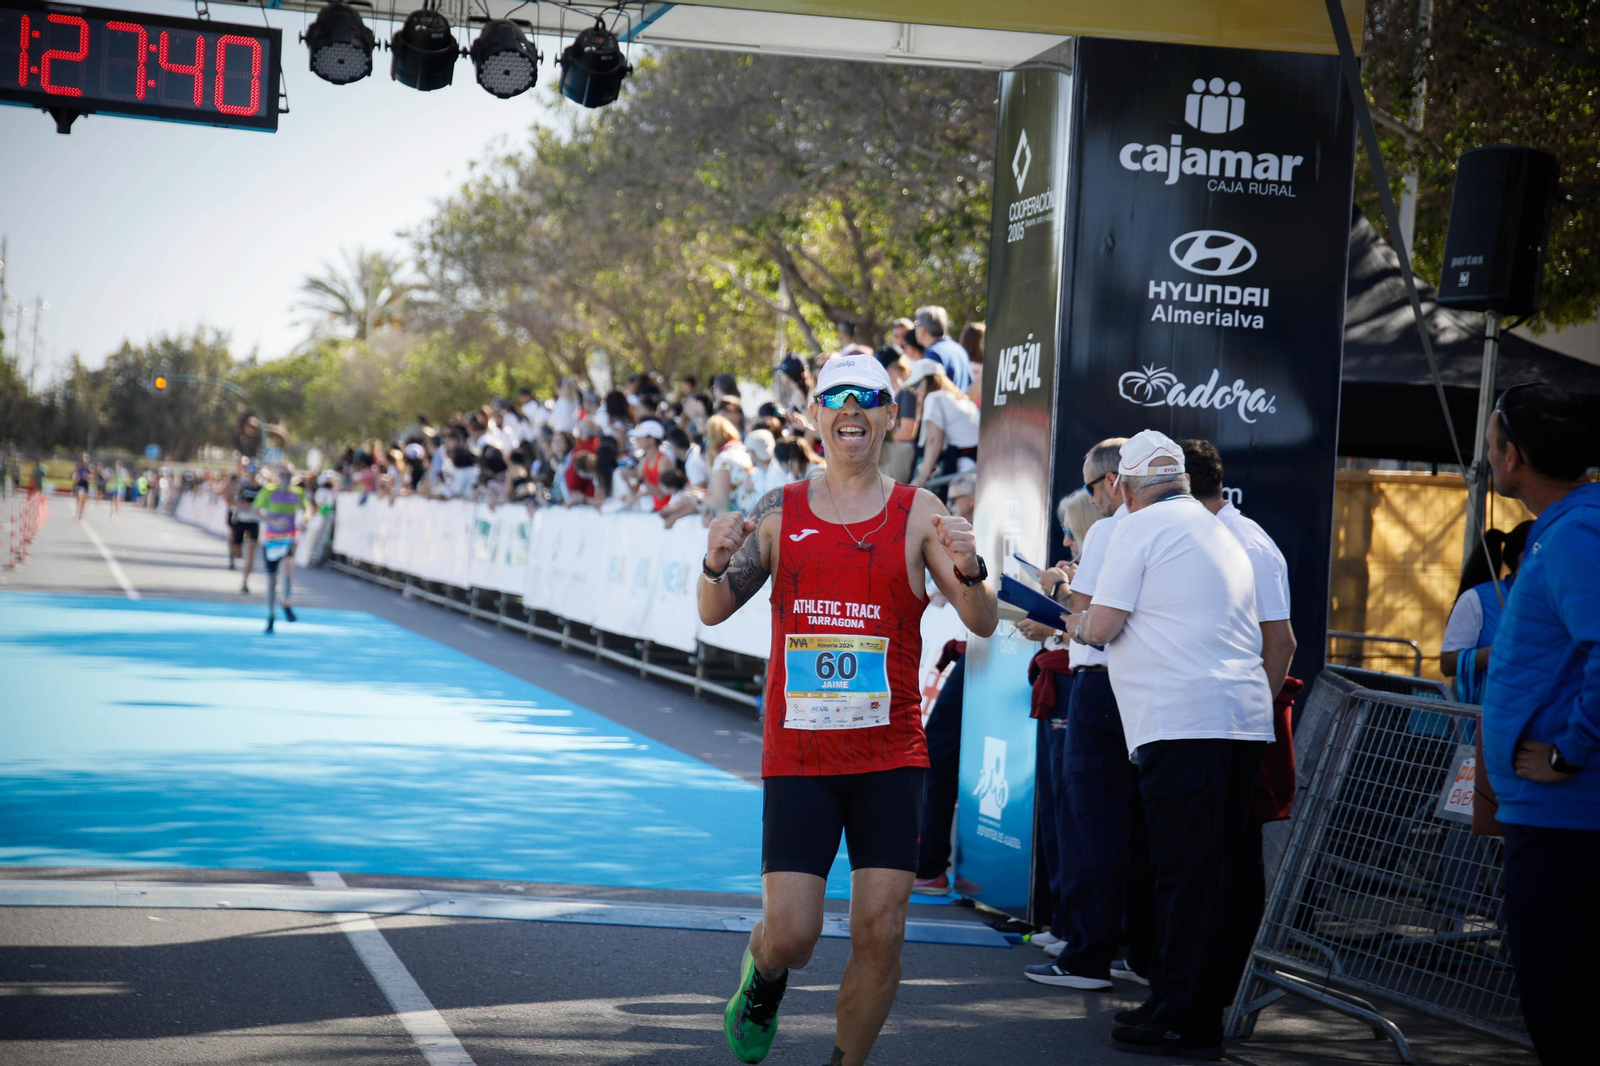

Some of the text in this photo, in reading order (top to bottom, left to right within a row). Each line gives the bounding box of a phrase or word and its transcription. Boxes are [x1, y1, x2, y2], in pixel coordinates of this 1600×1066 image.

[1119, 133, 1304, 185] cajamar
[1207, 178, 1296, 198] CAJA RURAL
[1007, 221, 1025, 243] 2005
[1148, 280, 1270, 308] HYUNDAI
[1150, 304, 1265, 329] Almerialva
[793, 599, 881, 620] ATHLETIC TRACK
[807, 615, 865, 629] TARRAGONA
[815, 651, 858, 680] 60
[821, 681, 849, 689] JAIME
